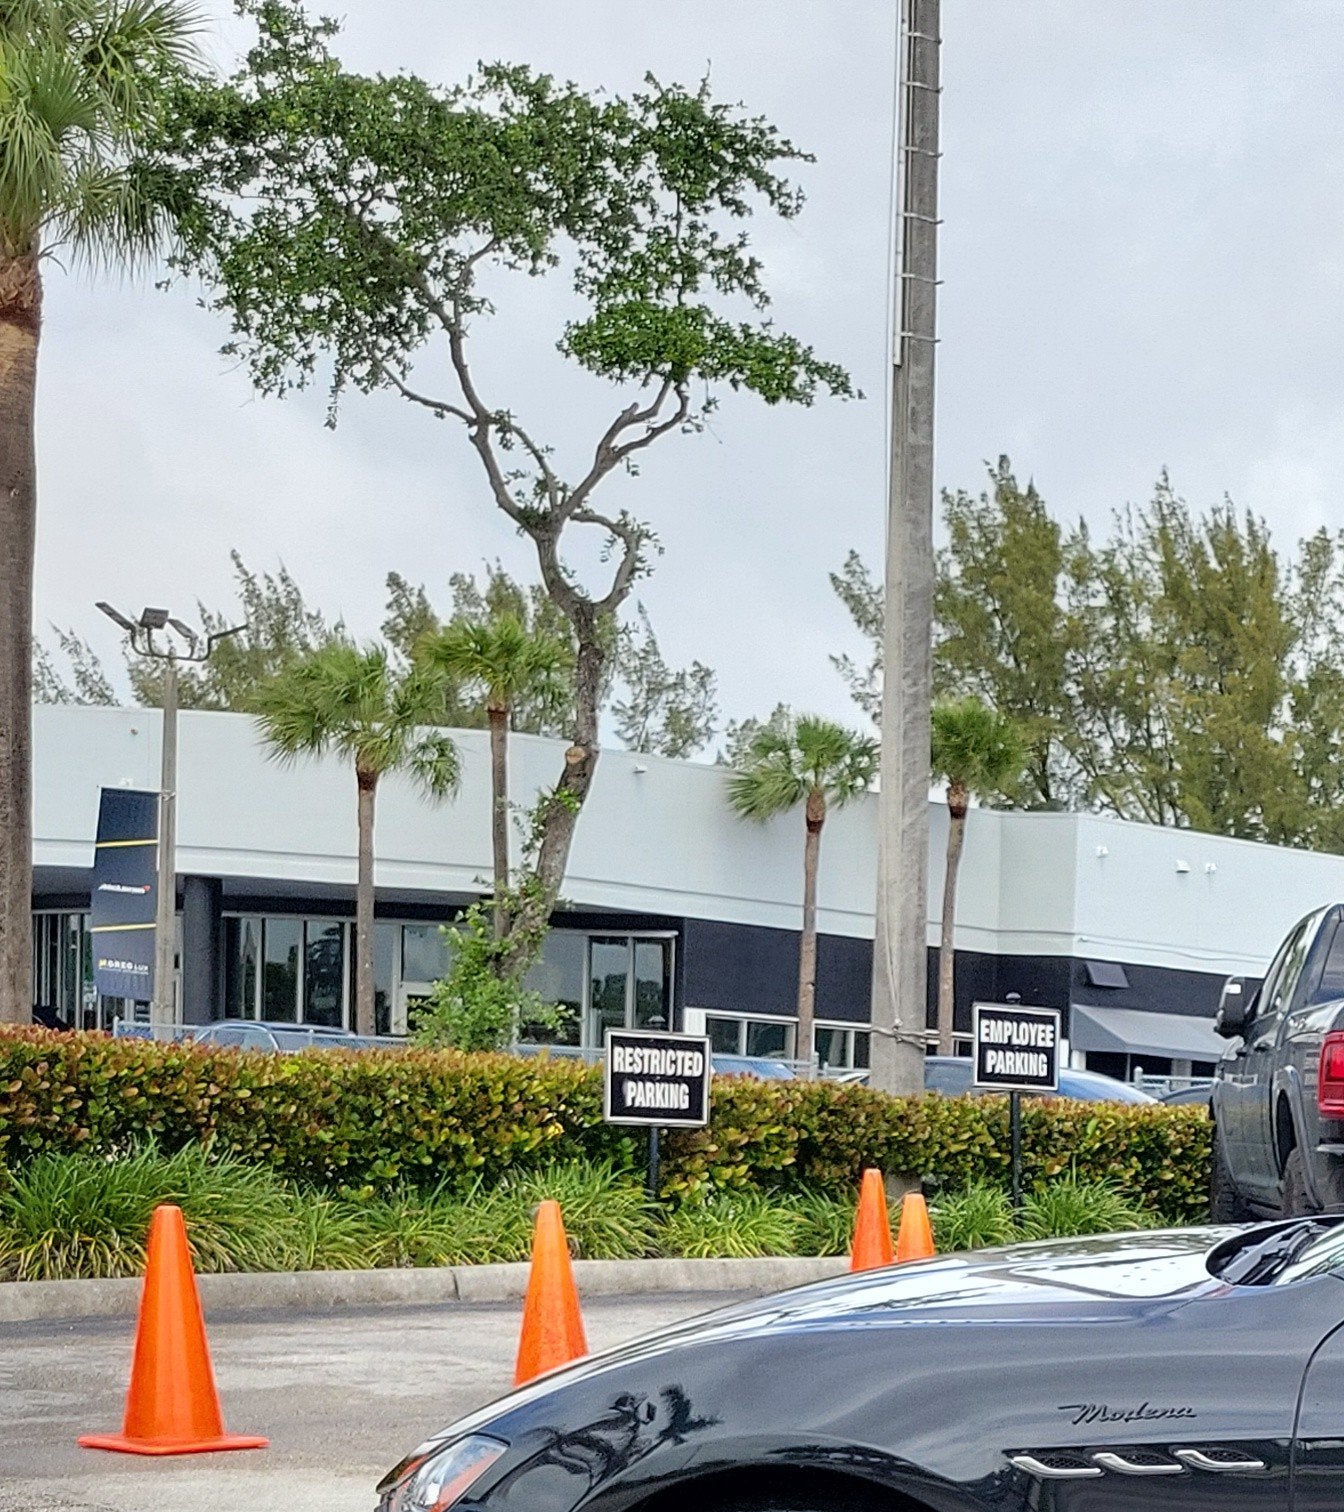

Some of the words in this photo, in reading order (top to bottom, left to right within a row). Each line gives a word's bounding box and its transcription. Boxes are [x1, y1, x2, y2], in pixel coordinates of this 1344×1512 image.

[979, 1019, 1055, 1048] EMPLOYEE
[612, 1046, 704, 1079] RESTRICTED
[986, 1048, 1048, 1078] PARKING
[624, 1078, 690, 1110] PARKING
[1058, 1401, 1198, 1425] Modena
